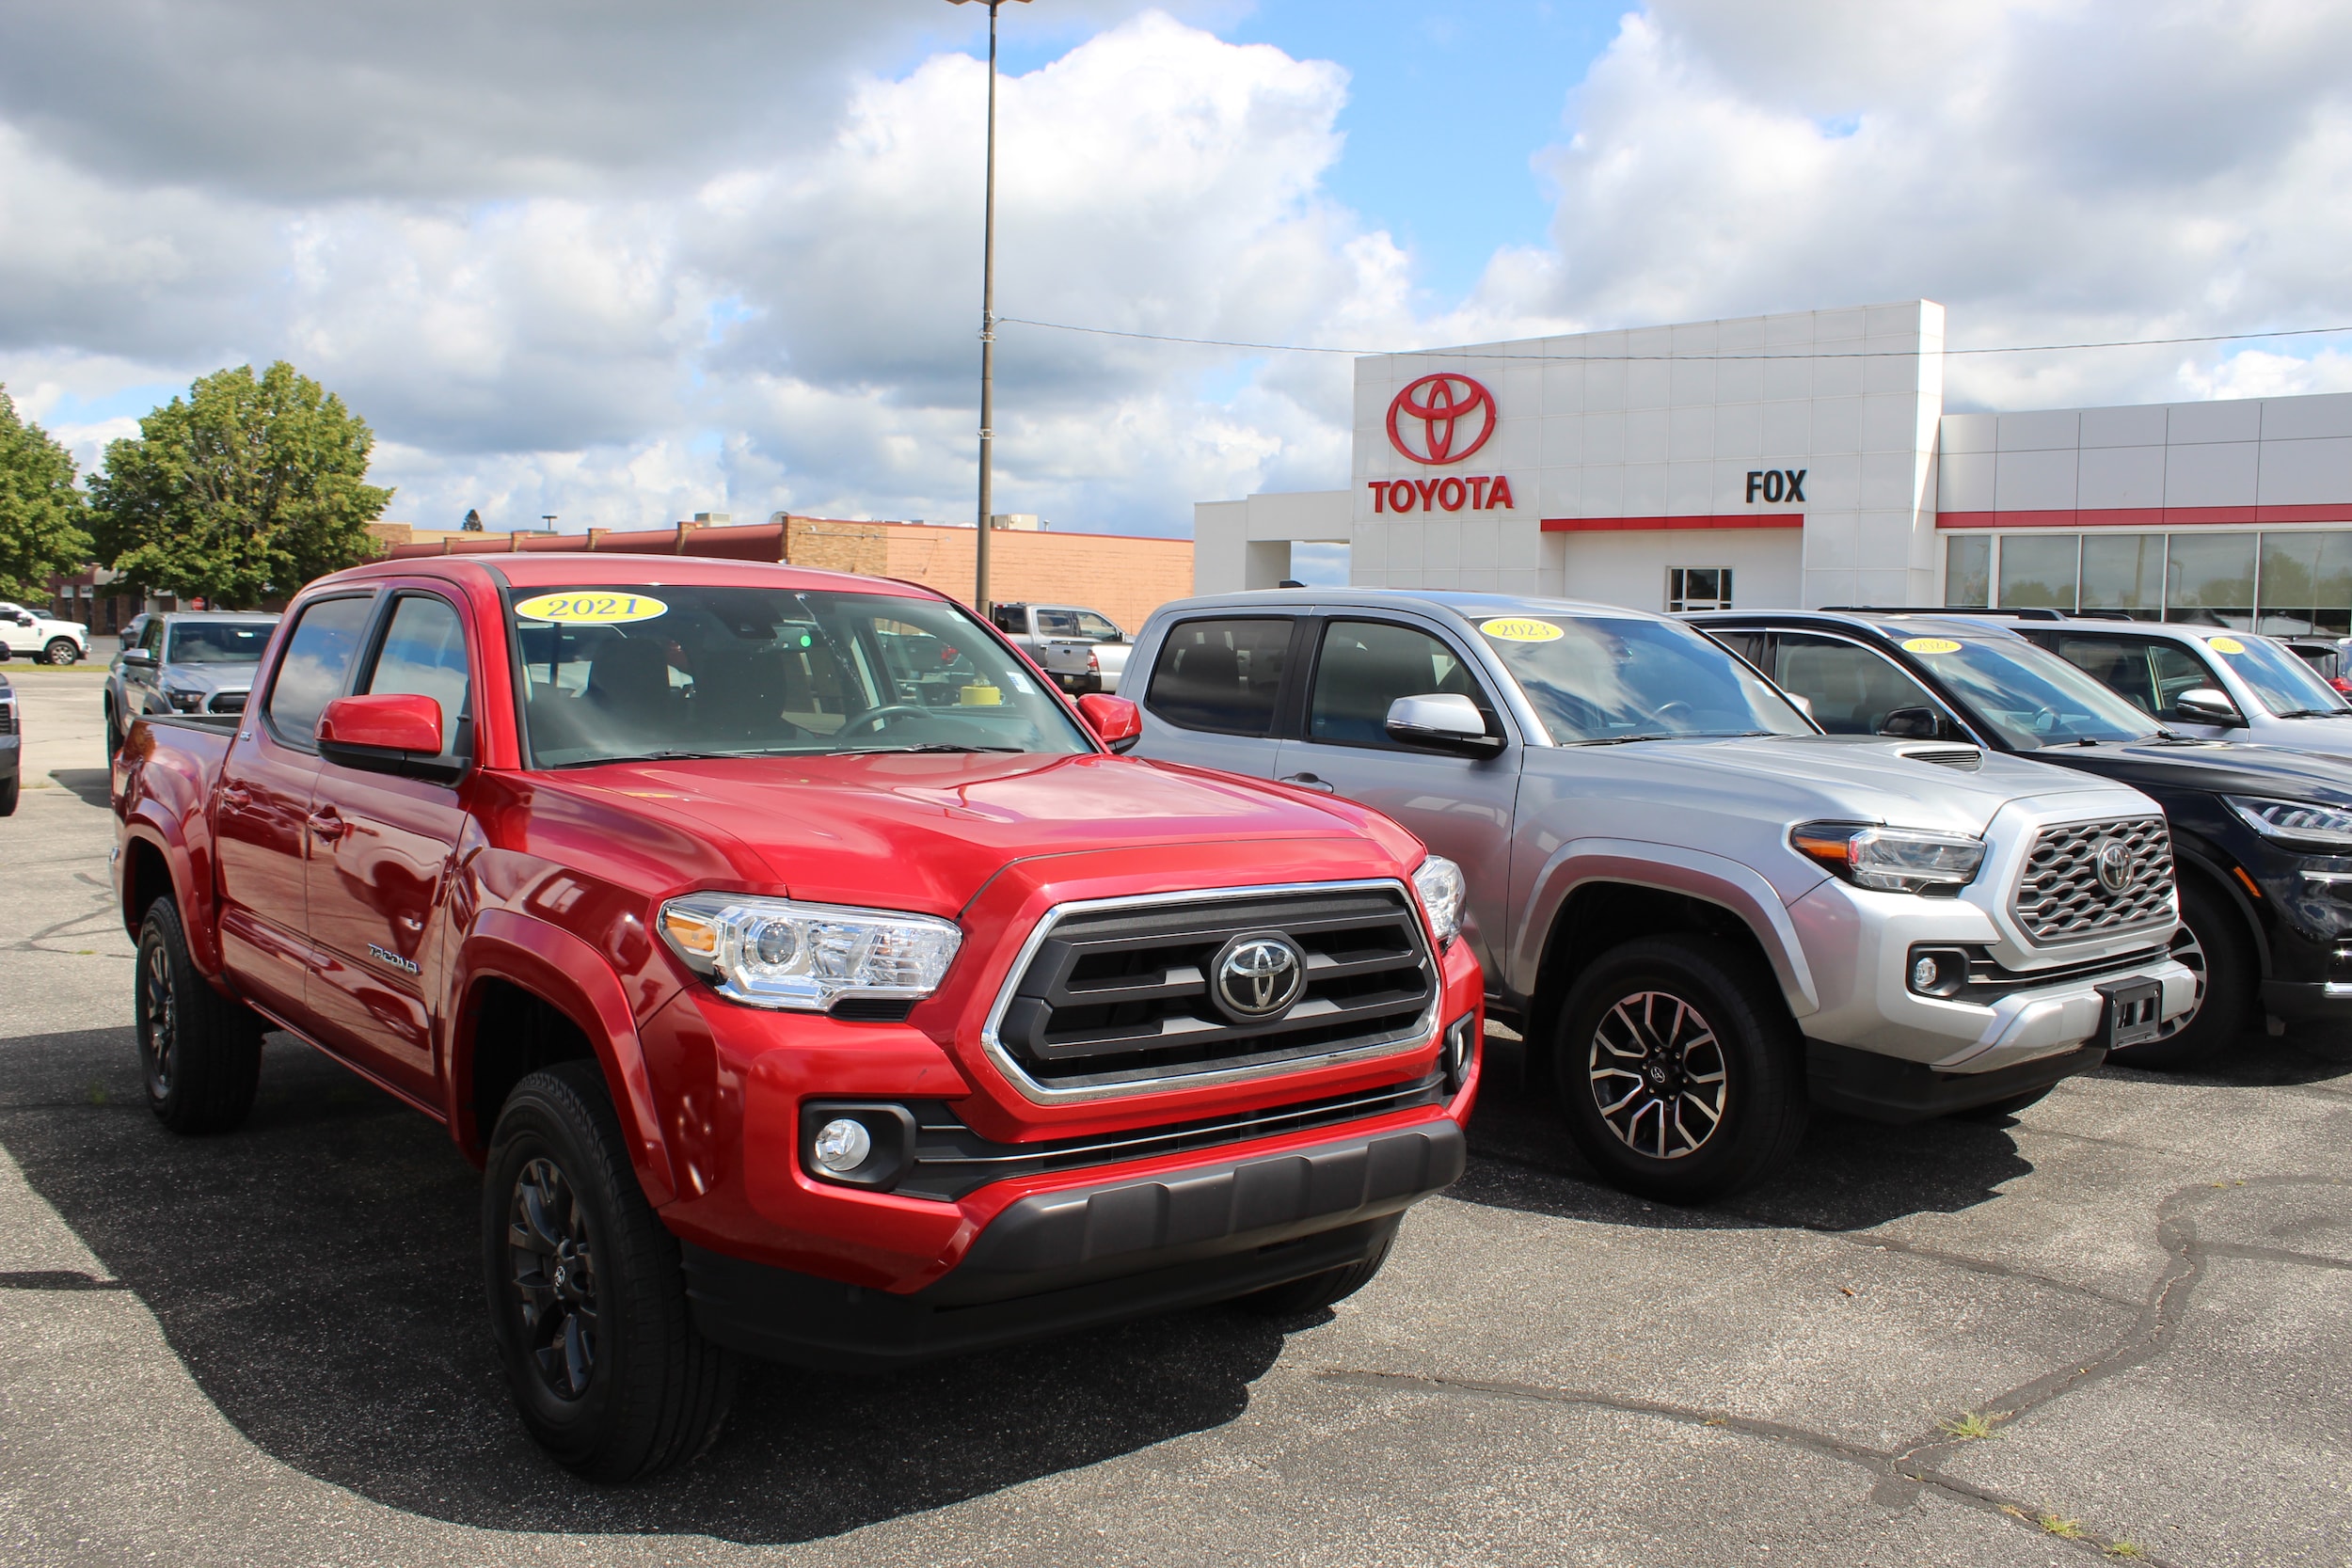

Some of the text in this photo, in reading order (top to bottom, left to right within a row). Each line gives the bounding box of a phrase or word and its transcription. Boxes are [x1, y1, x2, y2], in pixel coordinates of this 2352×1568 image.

[1368, 475, 1515, 514] TOYOTA
[1746, 469, 1807, 503] FOX
[547, 598, 640, 617] 2021
[1497, 623, 1550, 637] 2023
